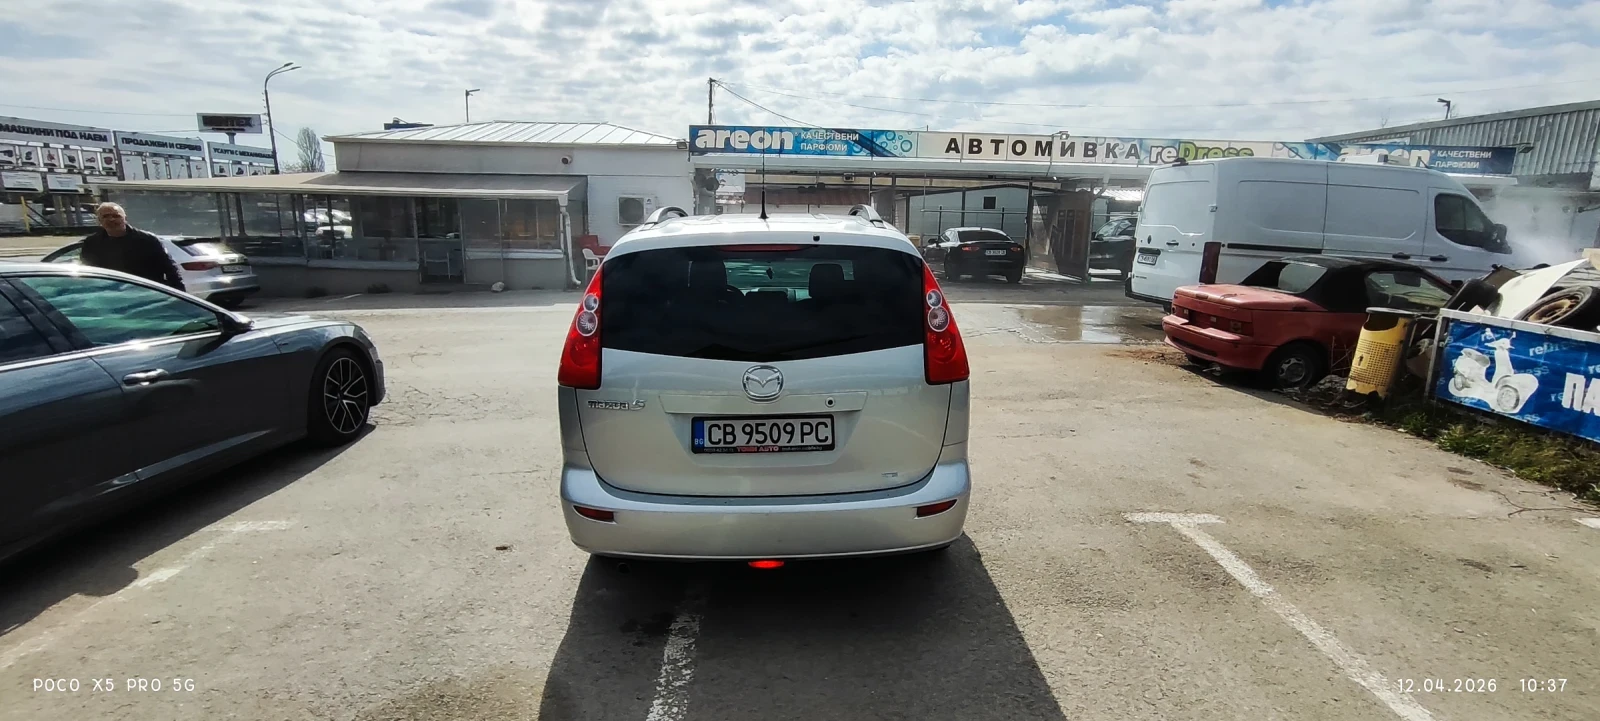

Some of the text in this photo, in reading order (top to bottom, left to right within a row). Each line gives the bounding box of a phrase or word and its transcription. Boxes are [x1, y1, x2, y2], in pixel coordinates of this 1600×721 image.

[0, 123, 108, 142] МАШИНИ ПОД НАЕМ
[800, 131, 860, 142] КАЧЕСТВЕНИ
[120, 137, 168, 149] ПРОДАЖБИ
[695, 128, 794, 150] areon
[800, 142, 848, 152] ПАРФЮМИ
[944, 137, 1141, 160] АВТОМИВКА
[1437, 149, 1492, 159] КАЧЕСТВЕНИ
[1435, 160, 1480, 169] ПАРФЮМИ
[587, 400, 630, 411] mazda
[707, 421, 829, 446] CB 9509 PC
[694, 437, 704, 446] BG
